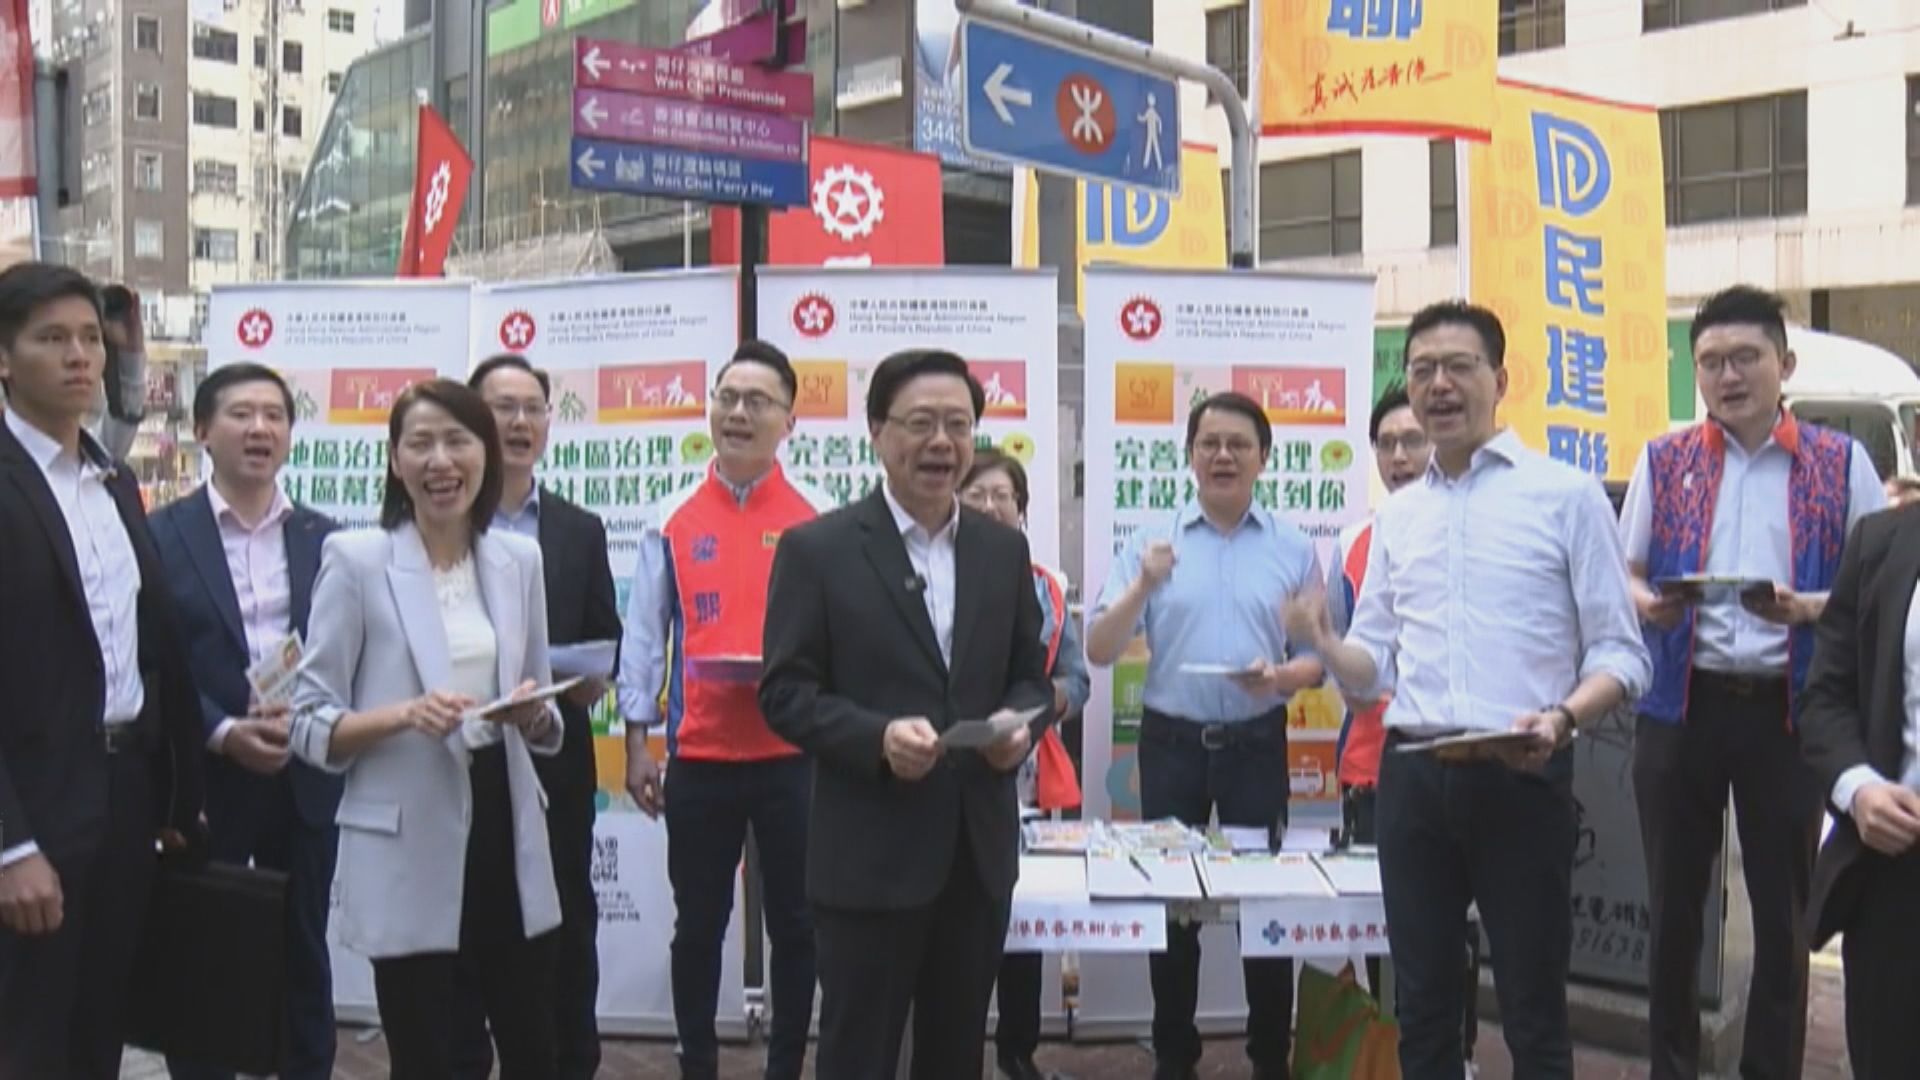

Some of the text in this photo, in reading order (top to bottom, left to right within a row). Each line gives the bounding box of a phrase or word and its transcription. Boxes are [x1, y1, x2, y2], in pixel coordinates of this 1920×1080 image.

[655, 75, 786, 106] Wan Chai Promenade
[652, 172, 774, 198] Wan Chai Ferry Pier
[1544, 224, 1608, 476] 民建聯
[541, 435, 673, 471] 地區治理
[1291, 921, 1389, 944] 香港島各界
